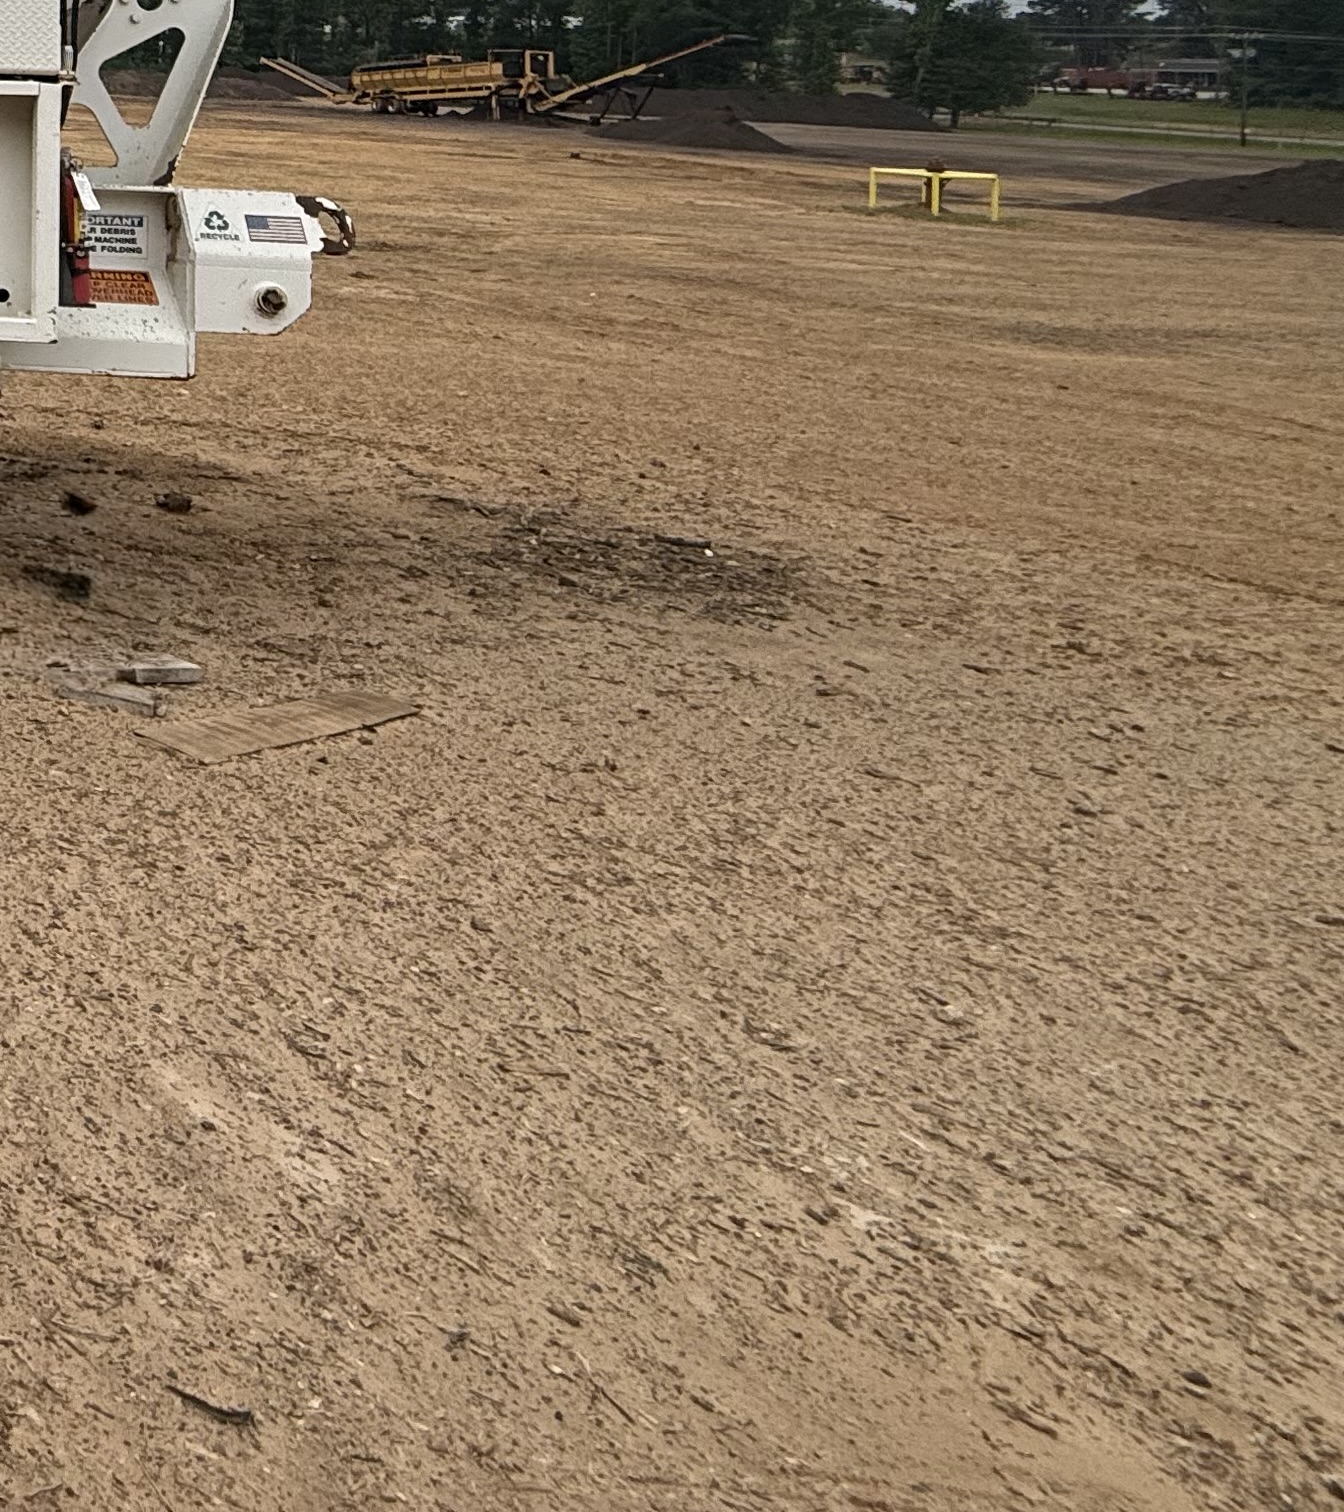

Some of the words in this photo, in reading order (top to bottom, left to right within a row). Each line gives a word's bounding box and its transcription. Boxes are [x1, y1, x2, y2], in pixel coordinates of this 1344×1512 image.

[87, 216, 141, 226] ORTANT
[100, 227, 136, 236] DEBRIS
[94, 236, 138, 245] MACHINE
[199, 232, 240, 241] RECYCLE
[100, 245, 143, 255] FOLDING
[89, 271, 147, 281] RNING
[105, 281, 146, 289] CLEAR
[117, 294, 154, 304] LINES
